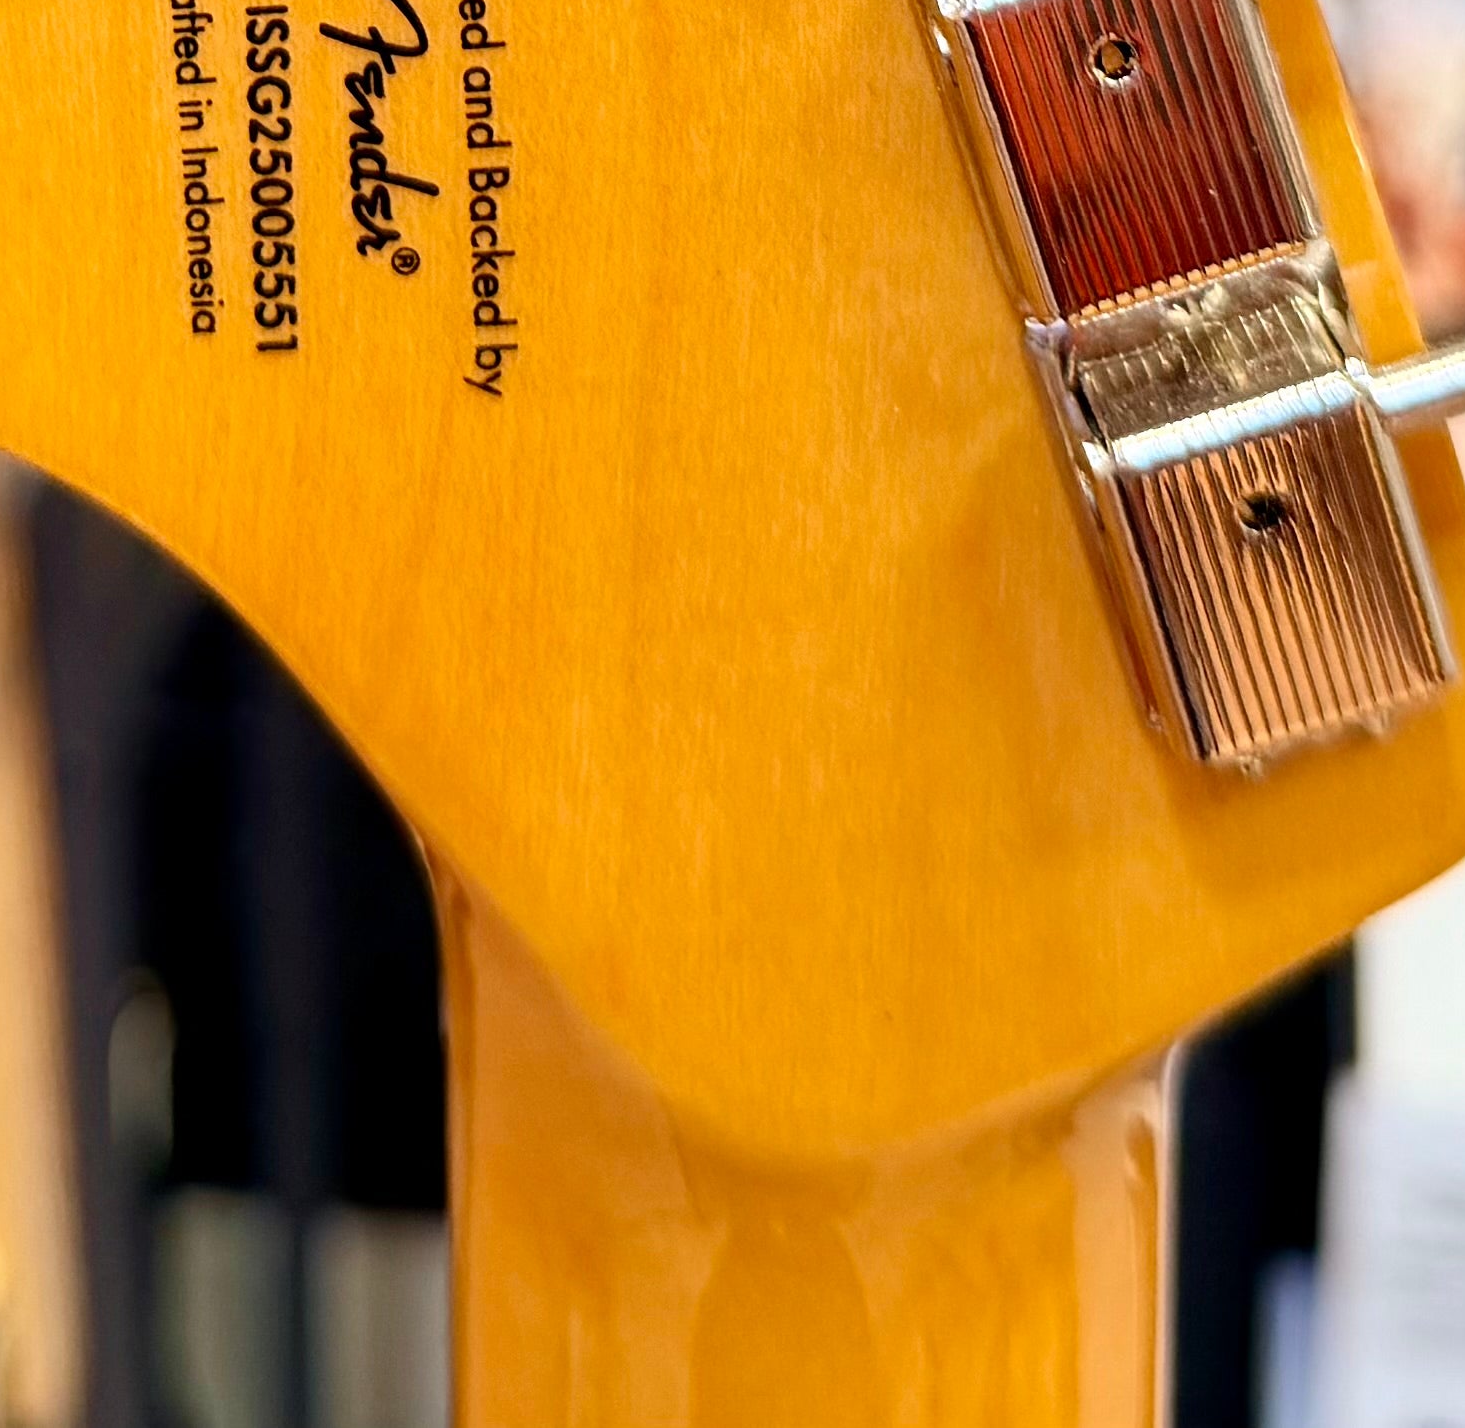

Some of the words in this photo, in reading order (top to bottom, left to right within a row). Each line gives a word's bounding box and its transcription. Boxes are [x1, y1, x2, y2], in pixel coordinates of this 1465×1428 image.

[178, 99, 213, 131] in
[462, 66, 512, 150] and
[245, 5, 298, 353] ISSG25005551
[181, 147, 225, 334] Indonesia
[468, 167, 518, 327] Backed
[464, 344, 518, 396] by
